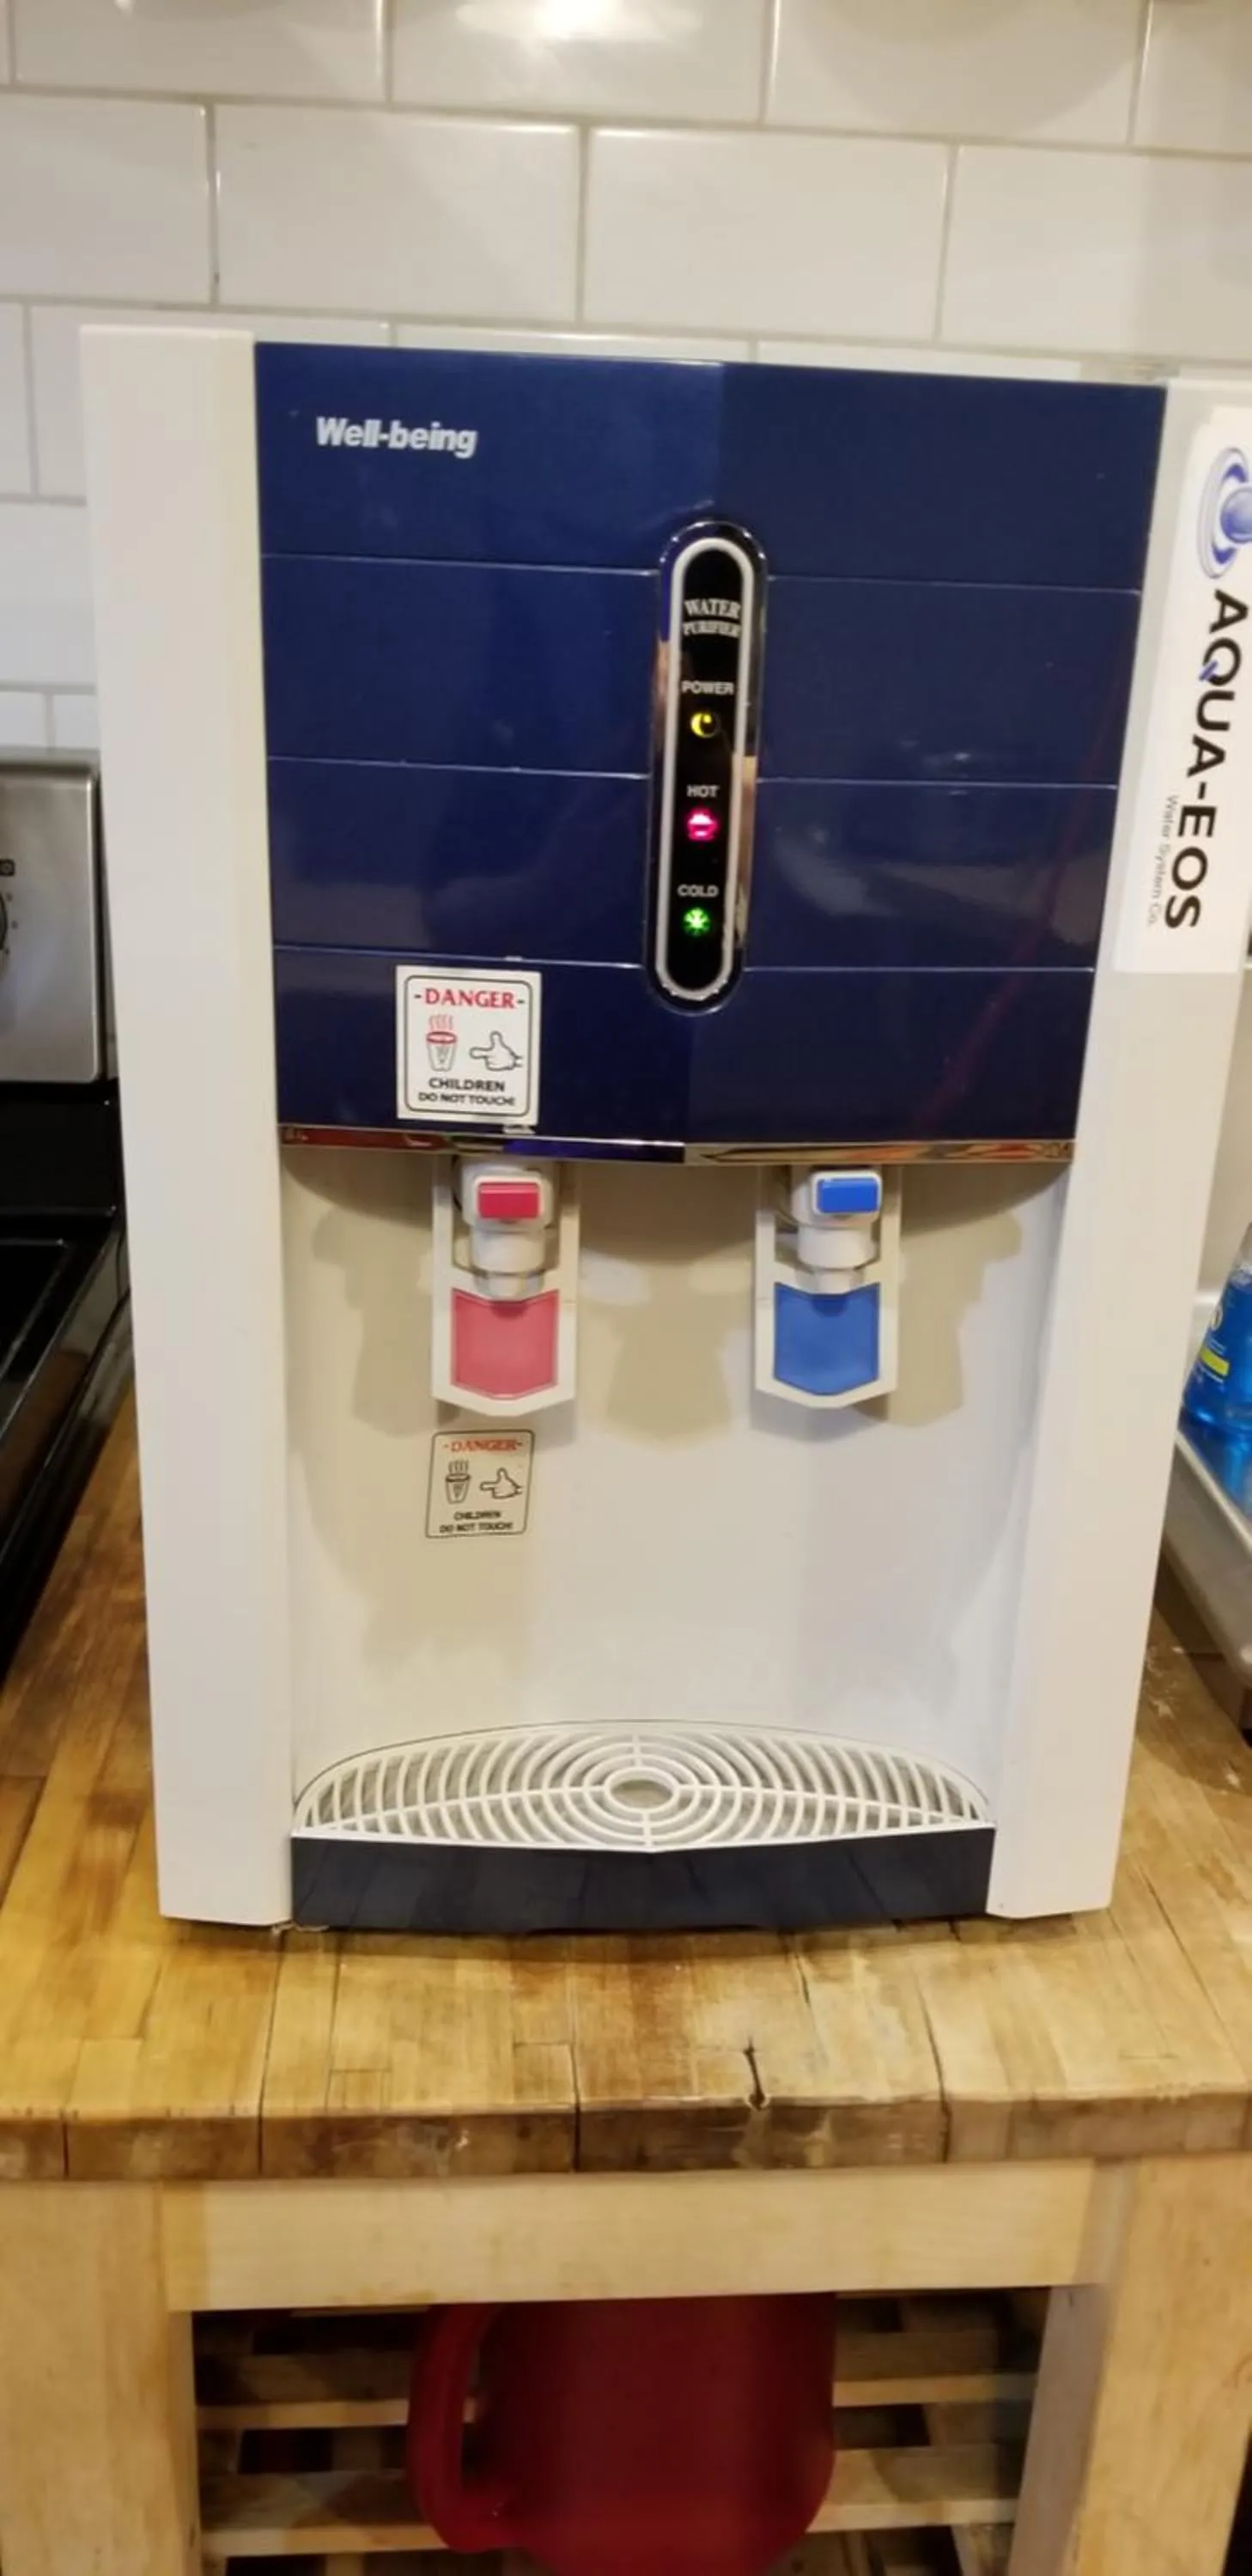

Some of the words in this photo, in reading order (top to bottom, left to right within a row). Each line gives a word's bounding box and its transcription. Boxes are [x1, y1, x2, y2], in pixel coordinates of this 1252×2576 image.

[316, 416, 477, 459] Well-being
[684, 598, 741, 619] WATER
[683, 619, 741, 638] PURIFIER
[681, 681, 735, 696] POWER
[1164, 589, 1249, 928] AQUA-EOS
[687, 785, 720, 798] HOT
[1161, 794, 1179, 838] Water
[1152, 843, 1171, 899] System
[677, 884, 719, 898] COLD
[428, 1078, 505, 1092] CHILDREN
[417, 1091, 438, 1102] DO
[440, 1093, 465, 1103] NOT
